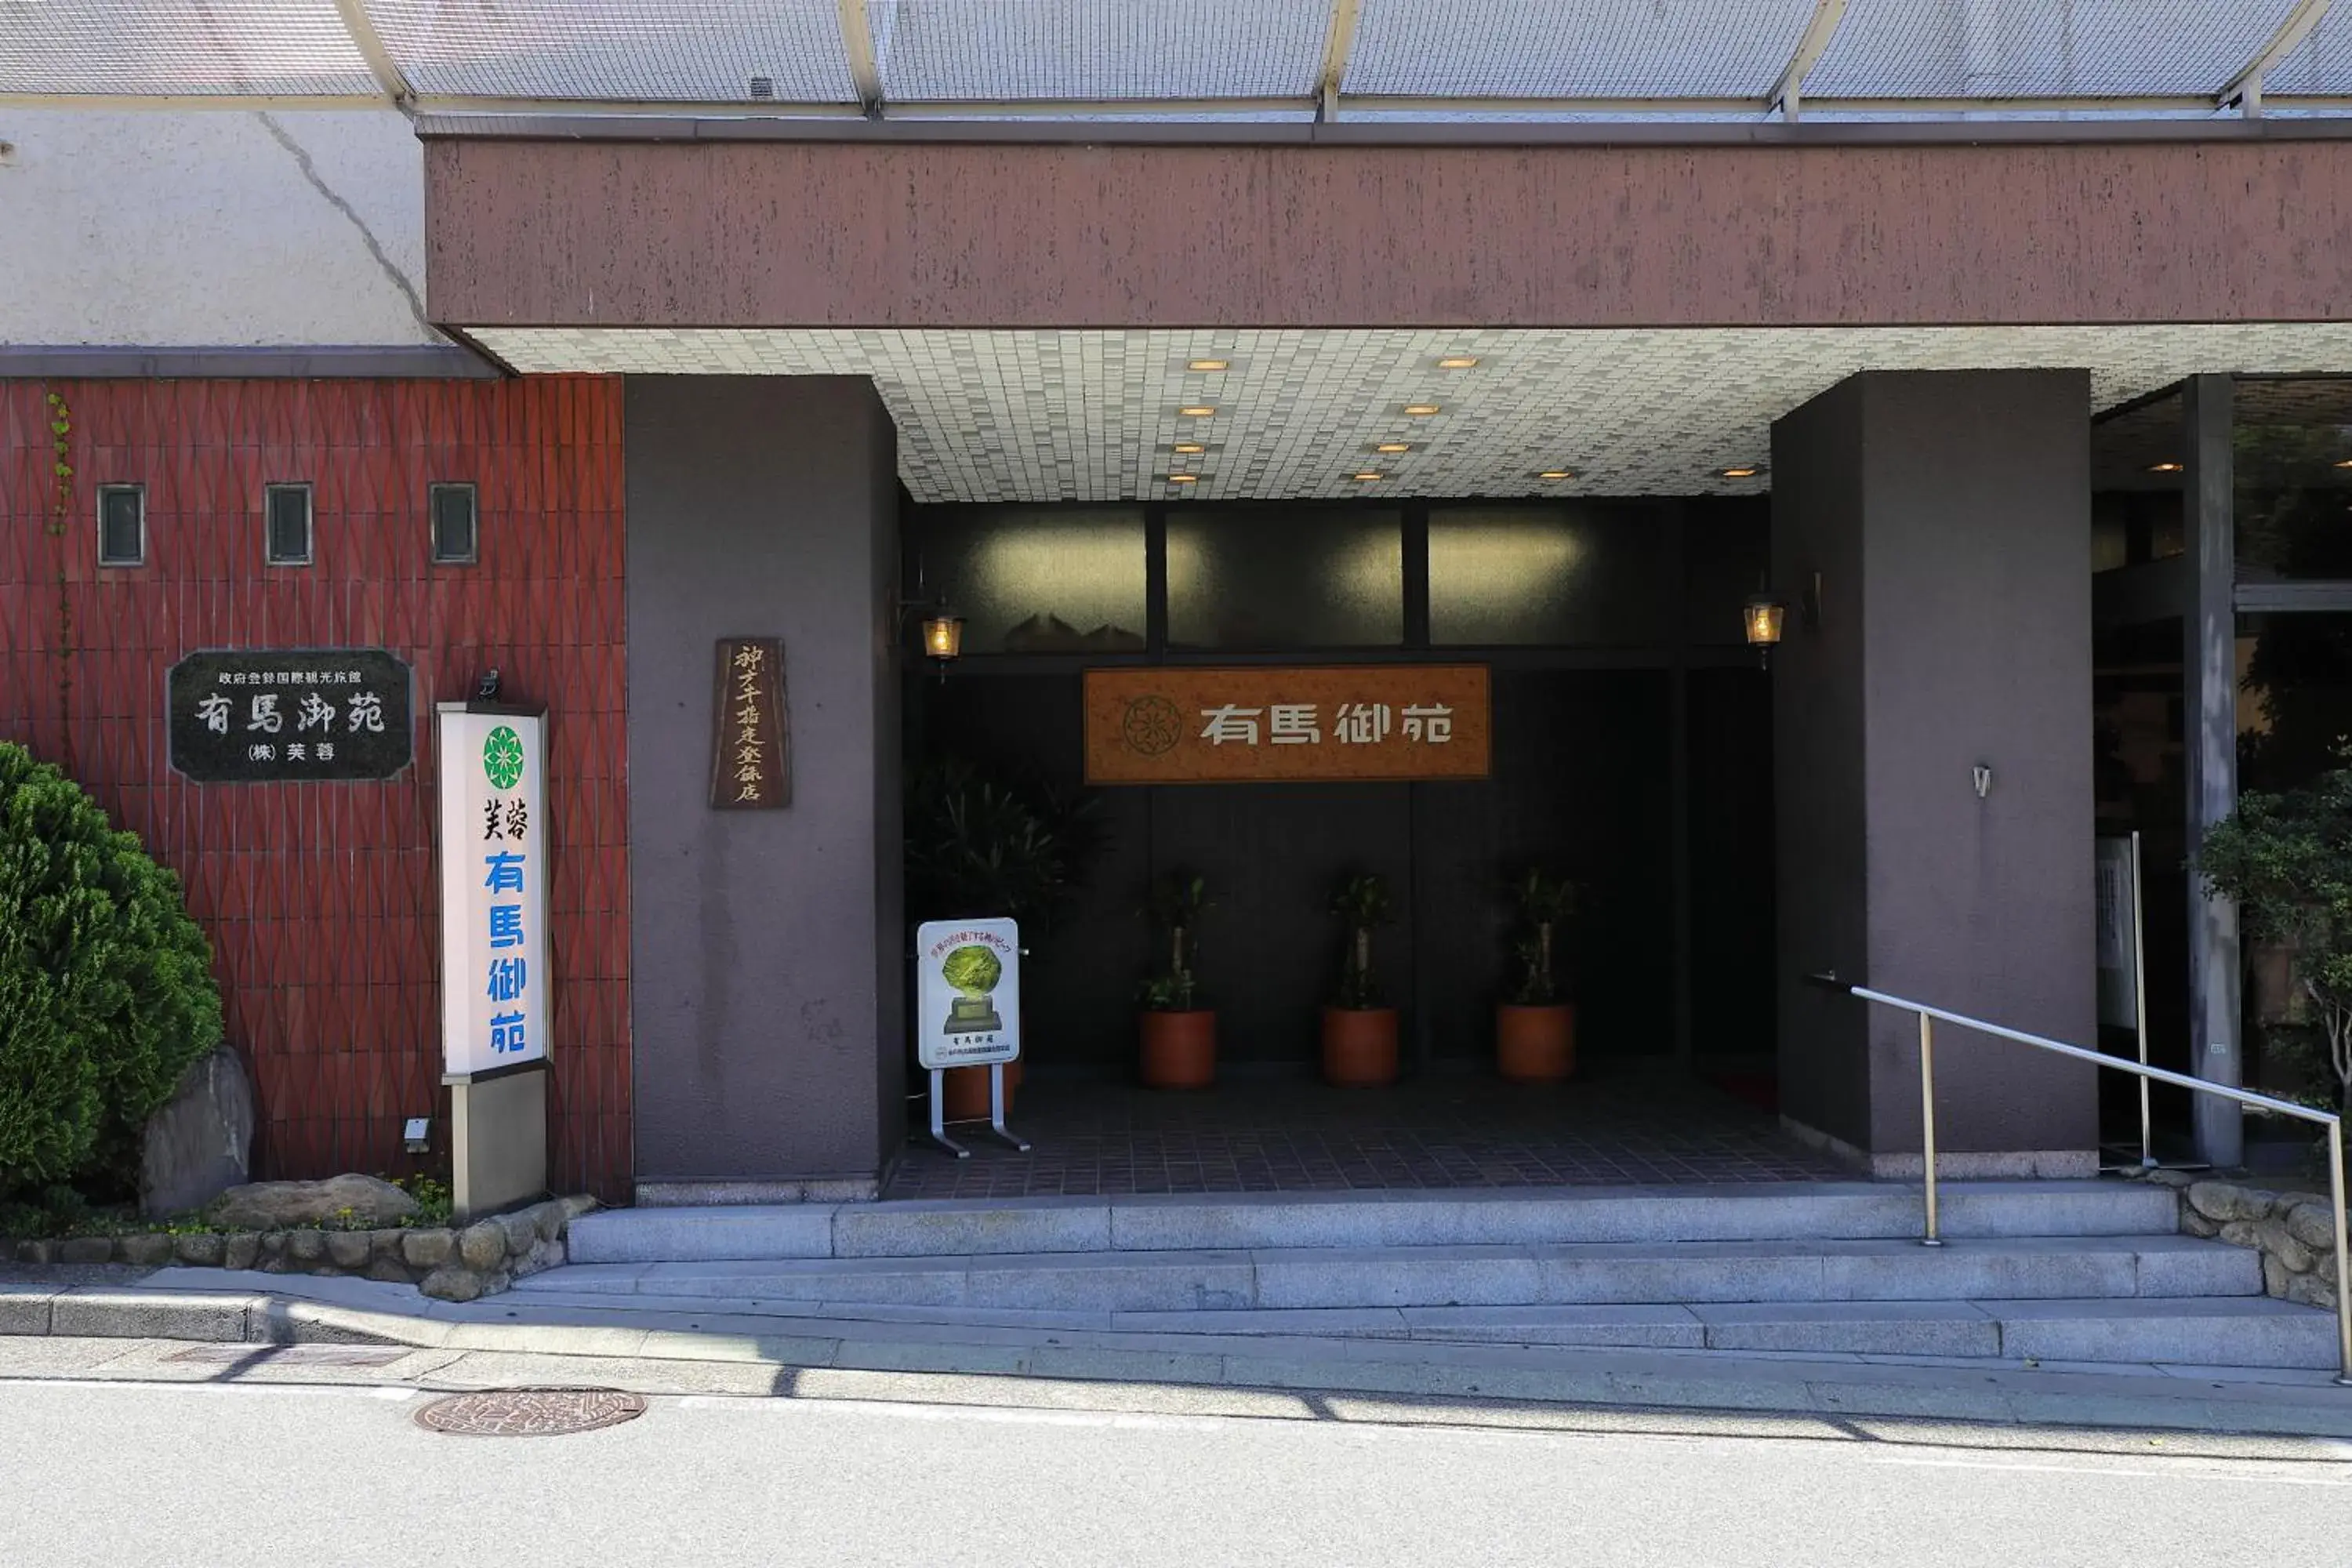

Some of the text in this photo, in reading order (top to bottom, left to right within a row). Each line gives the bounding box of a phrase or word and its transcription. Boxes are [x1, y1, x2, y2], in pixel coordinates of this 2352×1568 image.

[219, 671, 361, 684] 政府登録国際観光旅館
[194, 691, 385, 735] 有馬御苑
[1200, 703, 1454, 745] 有馬御苑
[483, 797, 528, 841] 芙蓉
[484, 851, 526, 1054] 有馬御苑
